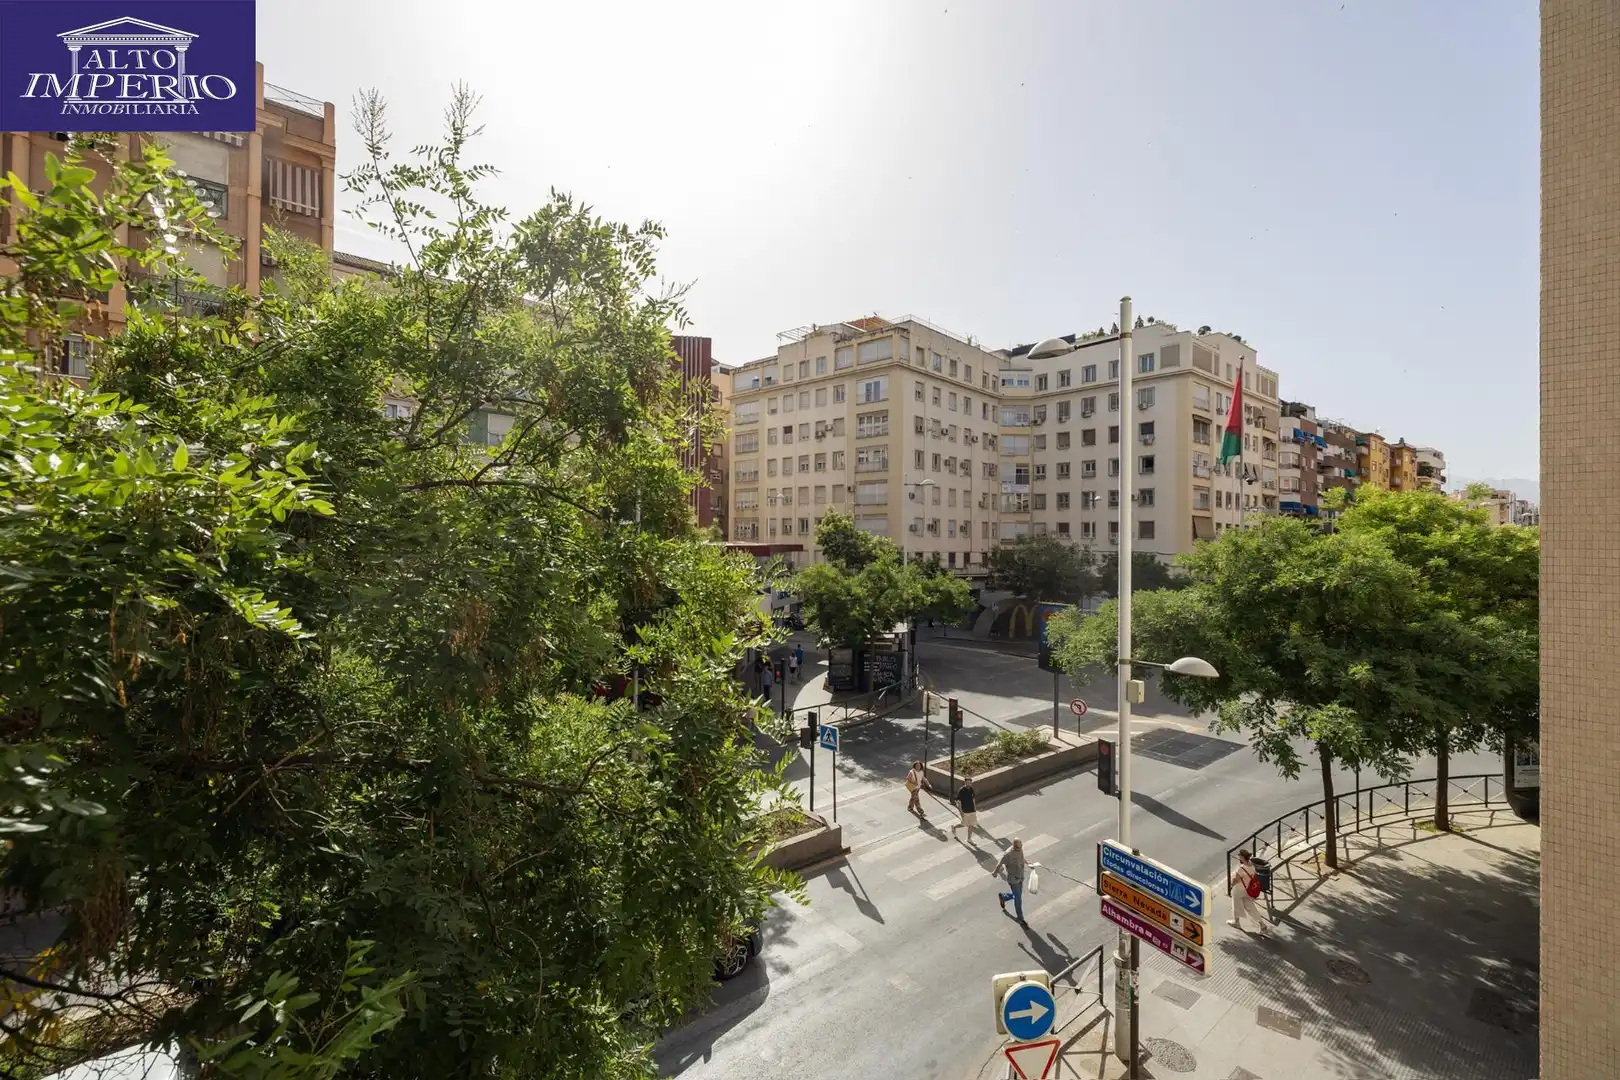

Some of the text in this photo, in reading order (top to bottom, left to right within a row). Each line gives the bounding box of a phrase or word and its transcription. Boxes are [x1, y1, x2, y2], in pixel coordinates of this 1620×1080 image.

[1103, 846, 1169, 886] Circunvalación
[1126, 870, 1169, 896] direcciones)
[1103, 879, 1168, 921] Sierra Nevada
[1102, 904, 1145, 936] Alhambra
